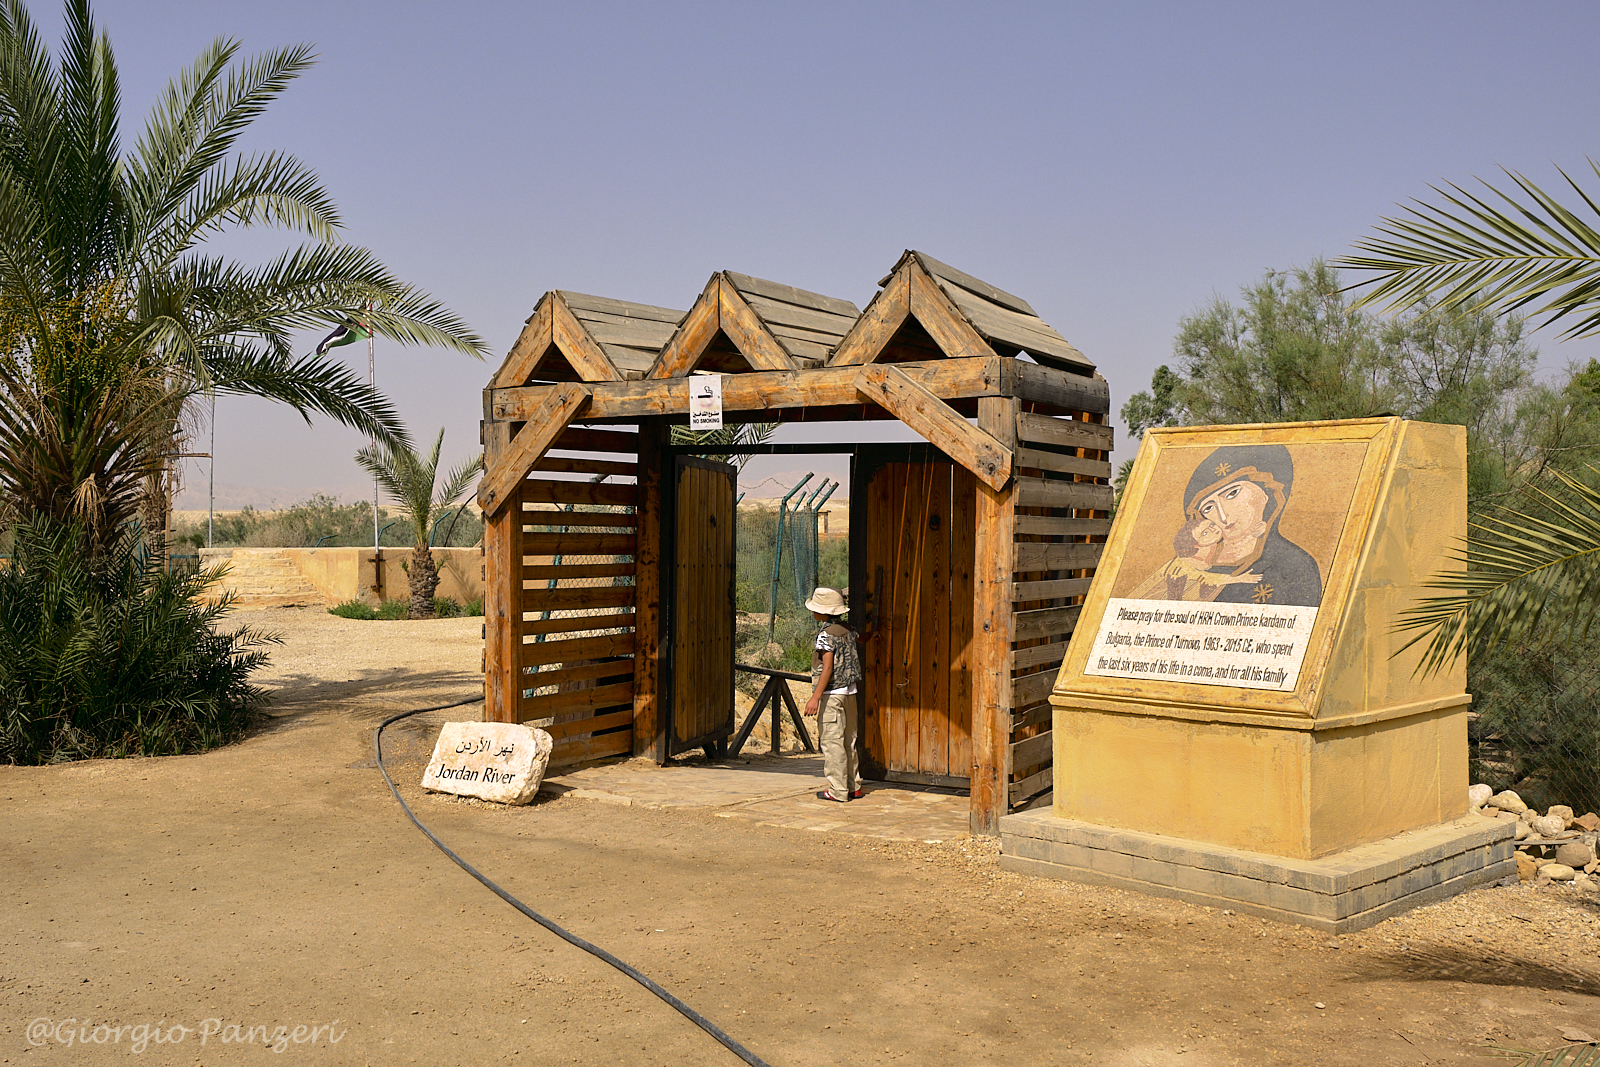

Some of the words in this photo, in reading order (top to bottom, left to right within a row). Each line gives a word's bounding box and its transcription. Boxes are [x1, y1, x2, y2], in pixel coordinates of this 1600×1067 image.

[1117, 607, 1139, 621] Please
[1137, 611, 1154, 625] pray
[1153, 609, 1164, 621] for
[1163, 610, 1176, 623] the
[1174, 611, 1189, 624] soul
[1189, 611, 1199, 624] of
[1197, 611, 1214, 625] HRH
[1213, 612, 1237, 626] Crown
[1235, 613, 1259, 627] Prince
[1286, 615, 1298, 629] of
[1105, 631, 1133, 647] Bulgaria,
[1133, 633, 1146, 646] the
[1144, 634, 1165, 648] Prince
[1164, 635, 1175, 649] of
[1173, 635, 1201, 651] Turnovo,
[1203, 637, 1220, 651] 1963
[1223, 638, 1242, 652] 2015
[1241, 639, 1254, 654] CE,
[1255, 640, 1272, 654] who
[1271, 642, 1294, 659] spent
[1098, 656, 1109, 670] the
[1107, 657, 1122, 671] last
[1120, 657, 1132, 671] six
[1130, 660, 1150, 674] years
[1149, 659, 1160, 673] of
[1157, 660, 1169, 674] his
[1168, 660, 1181, 675] life
[1179, 662, 1189, 676] in
[1187, 665, 1194, 676] a
[1193, 665, 1214, 679] coma,
[1214, 664, 1231, 679] and
[1228, 665, 1242, 679] for
[1240, 666, 1252, 681] all
[1250, 666, 1264, 681] his
[1262, 667, 1289, 688] family
[455, 736, 492, 755] الأردن
[493, 743, 515, 757] نهر
[435, 763, 479, 781] Jordan
[482, 767, 516, 785] River
